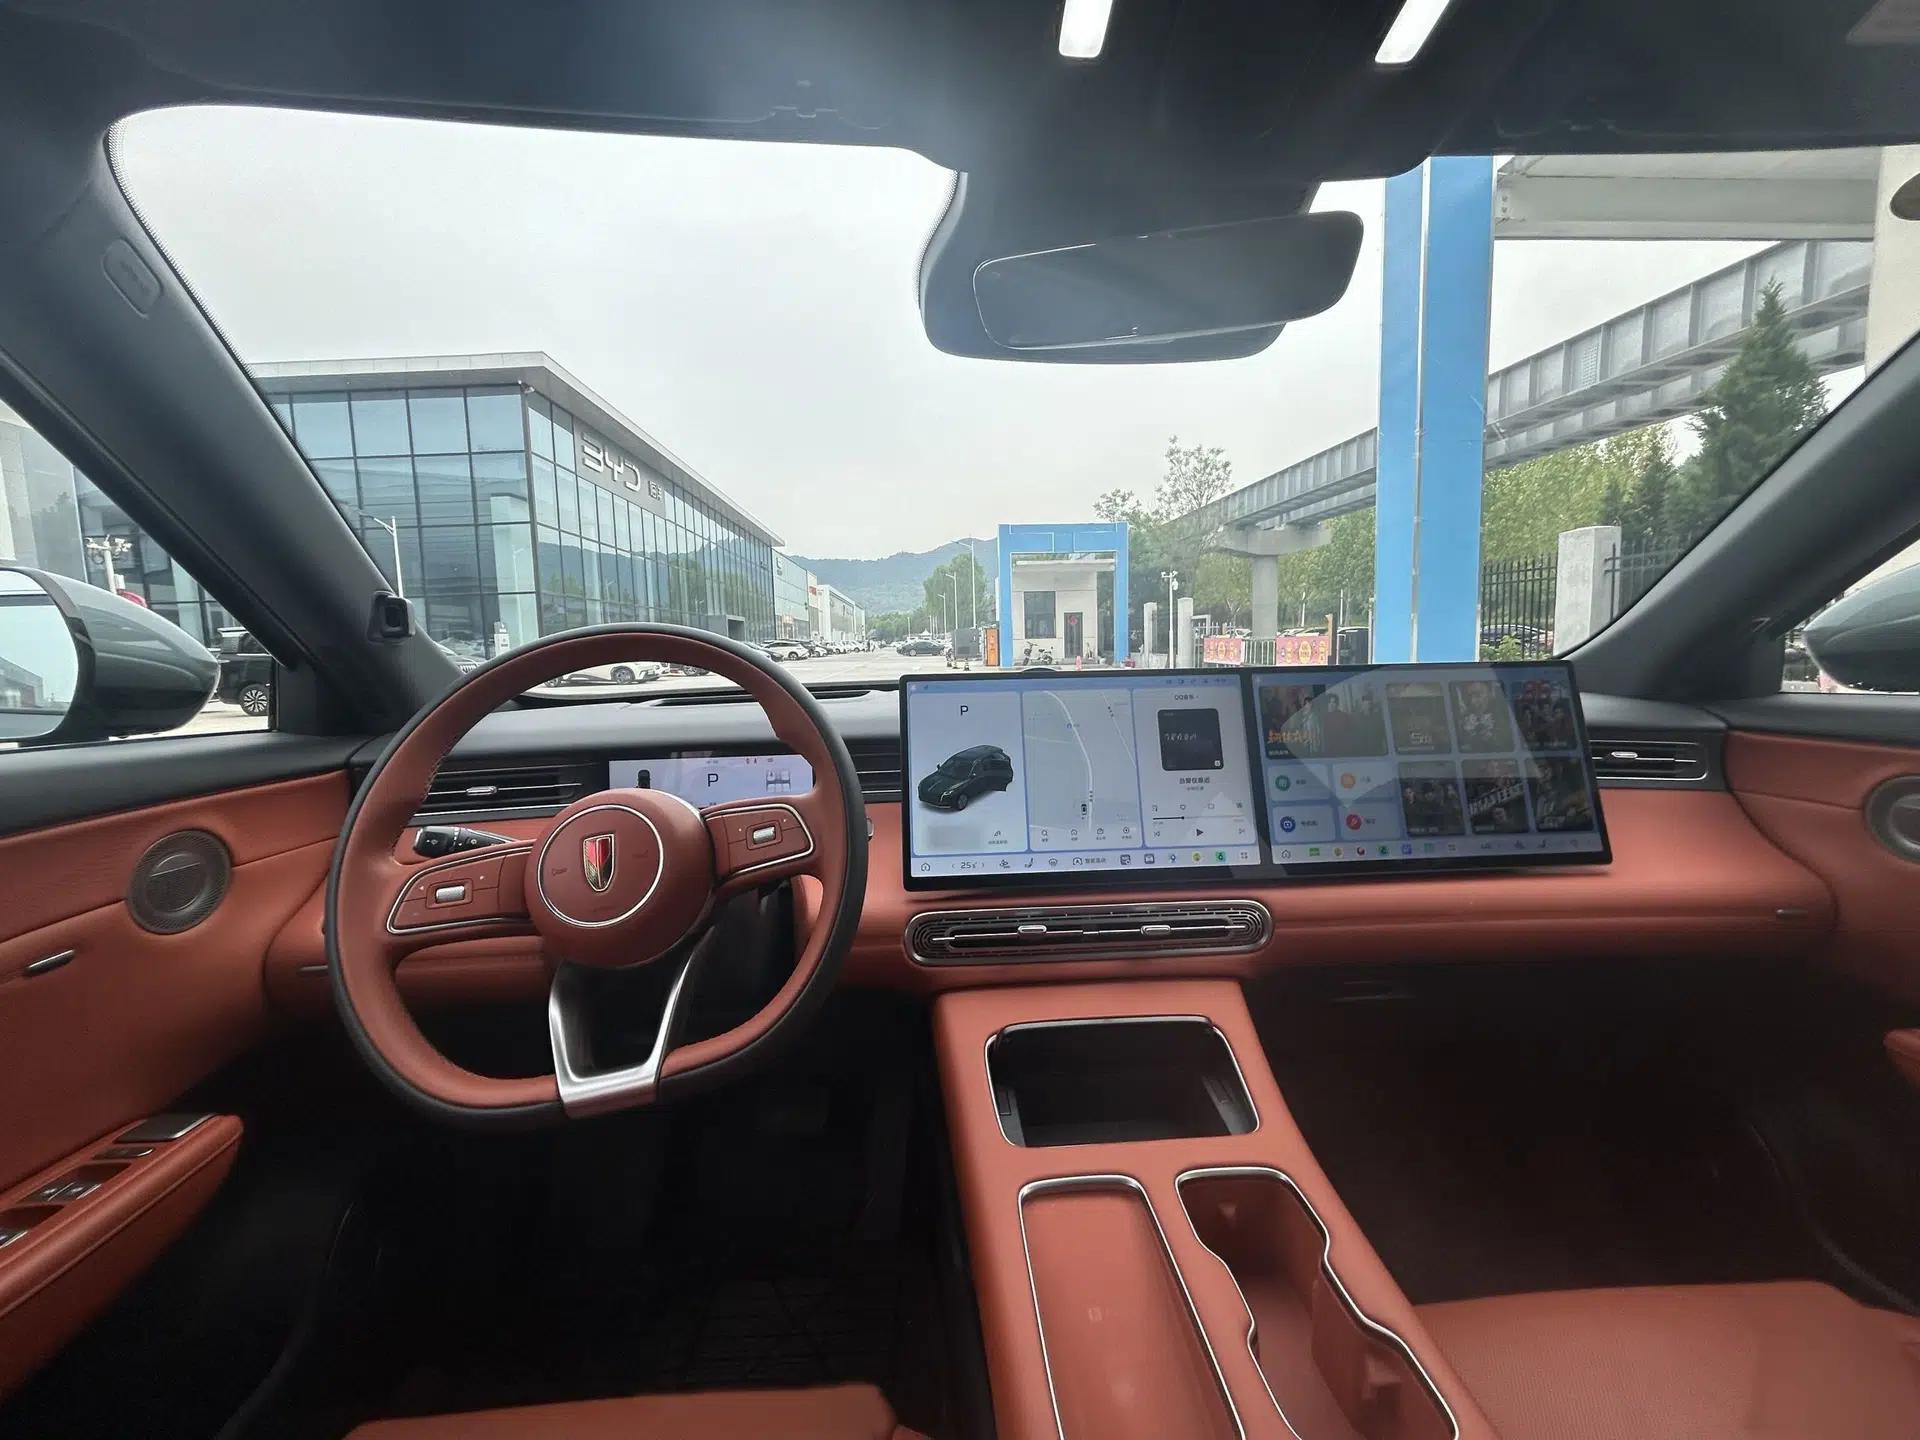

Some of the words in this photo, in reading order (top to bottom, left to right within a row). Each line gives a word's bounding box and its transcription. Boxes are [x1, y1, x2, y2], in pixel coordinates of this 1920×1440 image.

[582, 433, 641, 492] BYD
[960, 705, 969, 716] P
[707, 773, 719, 787] P
